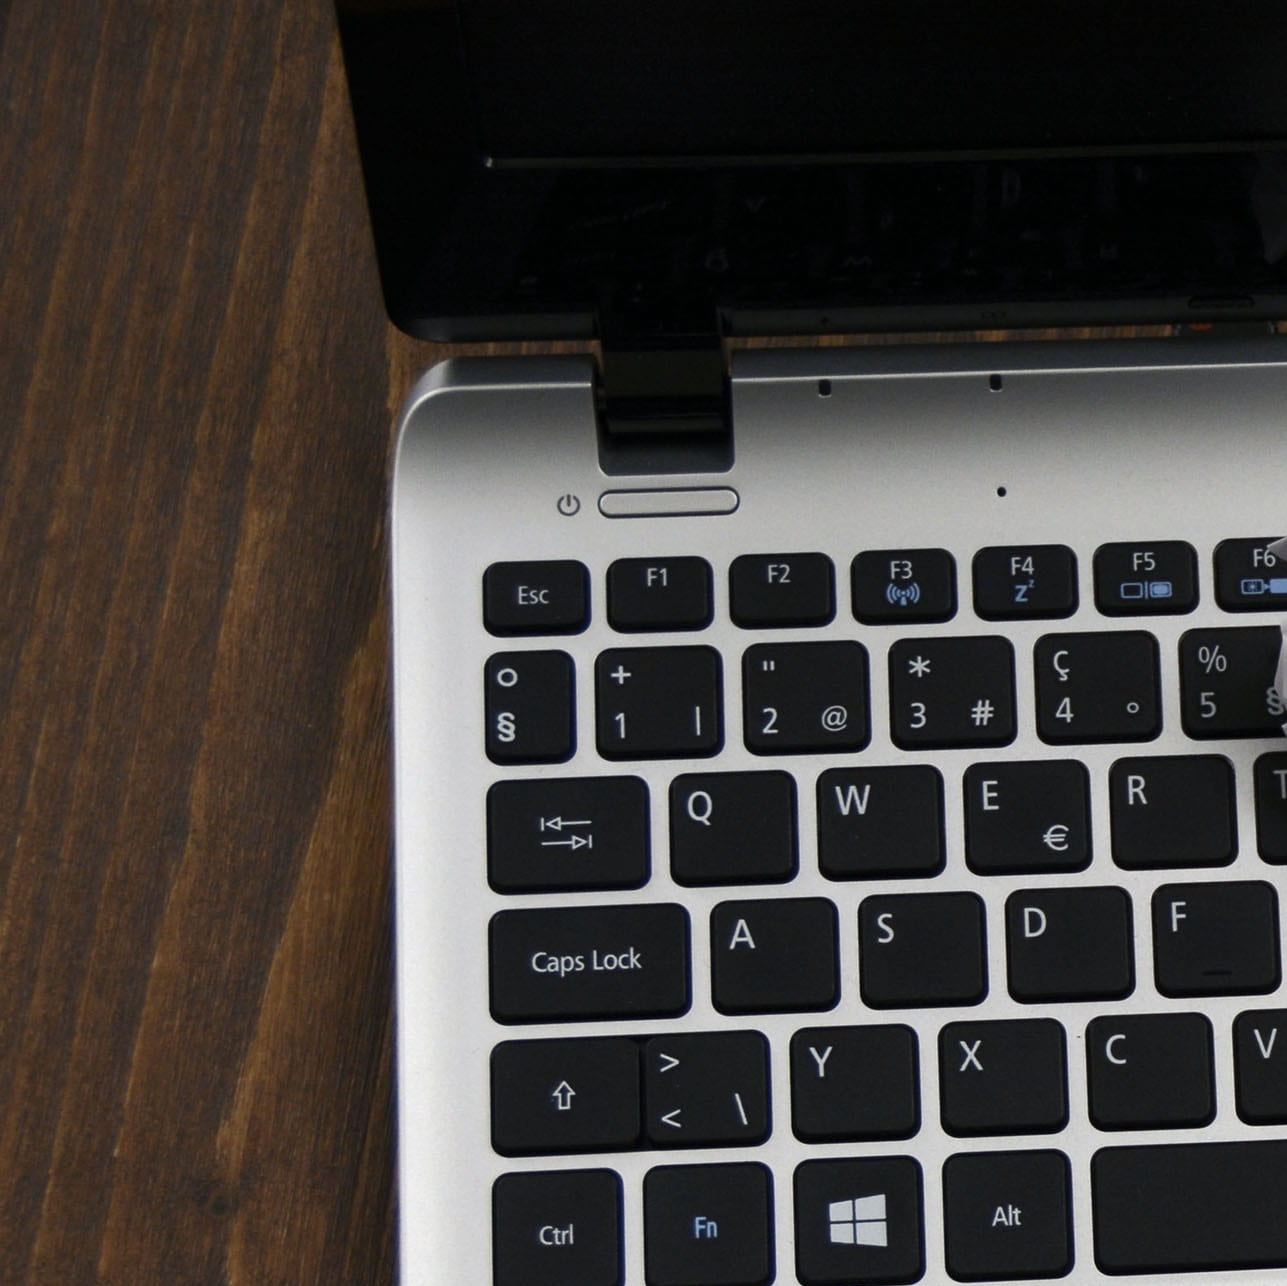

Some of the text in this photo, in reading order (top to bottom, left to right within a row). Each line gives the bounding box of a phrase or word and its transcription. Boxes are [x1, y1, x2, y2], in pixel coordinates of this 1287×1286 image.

[889, 560, 913, 581] F3
[1010, 556, 1035, 576] F4
[1132, 551, 1156, 572] F5
[1252, 548, 1277, 568] F6
[646, 567, 667, 587] F1
[767, 563, 791, 584] F2
[517, 585, 549, 605] Esc
[910, 702, 927, 729] 3
[1055, 696, 1074, 723] 4
[1200, 691, 1217, 718] 5
[496, 711, 516, 743] §
[613, 712, 627, 739] 1
[762, 707, 779, 734] 2
[834, 784, 871, 816] W
[981, 780, 1000, 811] E
[1127, 774, 1148, 806] R
[686, 790, 713, 826] Q
[1042, 824, 1070, 852] €
[876, 912, 895, 944] S
[1023, 907, 1047, 938] D
[1170, 901, 1187, 933] F
[729, 918, 756, 950] A
[531, 946, 643, 978] Caps Lock
[959, 1039, 984, 1072] X
[1105, 1033, 1127, 1065] C
[1253, 1027, 1278, 1059] V
[808, 1045, 833, 1078] Y
[693, 1216, 718, 1239] Fn
[991, 1204, 1022, 1227] Alt
[538, 1223, 574, 1246] Ctrl
